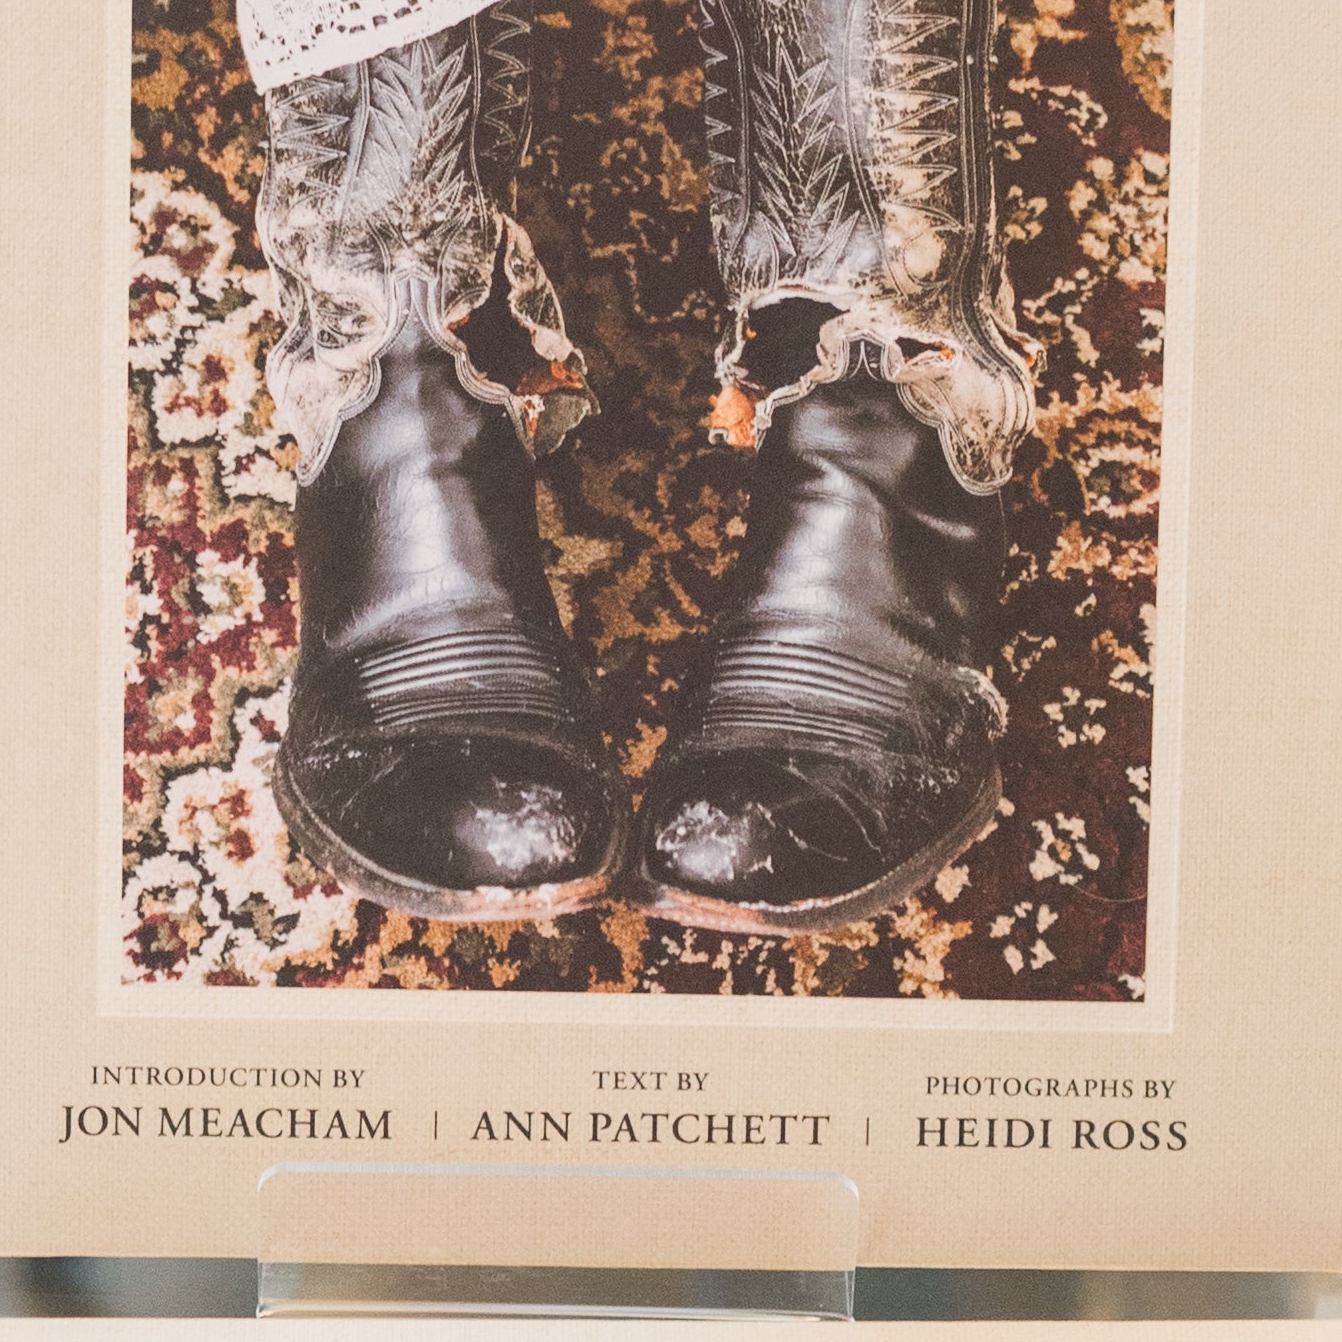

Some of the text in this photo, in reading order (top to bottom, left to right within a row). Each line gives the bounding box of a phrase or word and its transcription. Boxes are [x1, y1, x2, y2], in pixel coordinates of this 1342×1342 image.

[91, 1065, 366, 1090] INTRODUCTION BY
[593, 1070, 710, 1092] TEXT BY
[925, 1075, 1178, 1101] PHOTOGRAPHS BY
[57, 1104, 392, 1145] JON MEACHAM
[470, 1110, 831, 1147] ANN PATCHETT
[916, 1116, 1188, 1152] HEIDI ROSS
